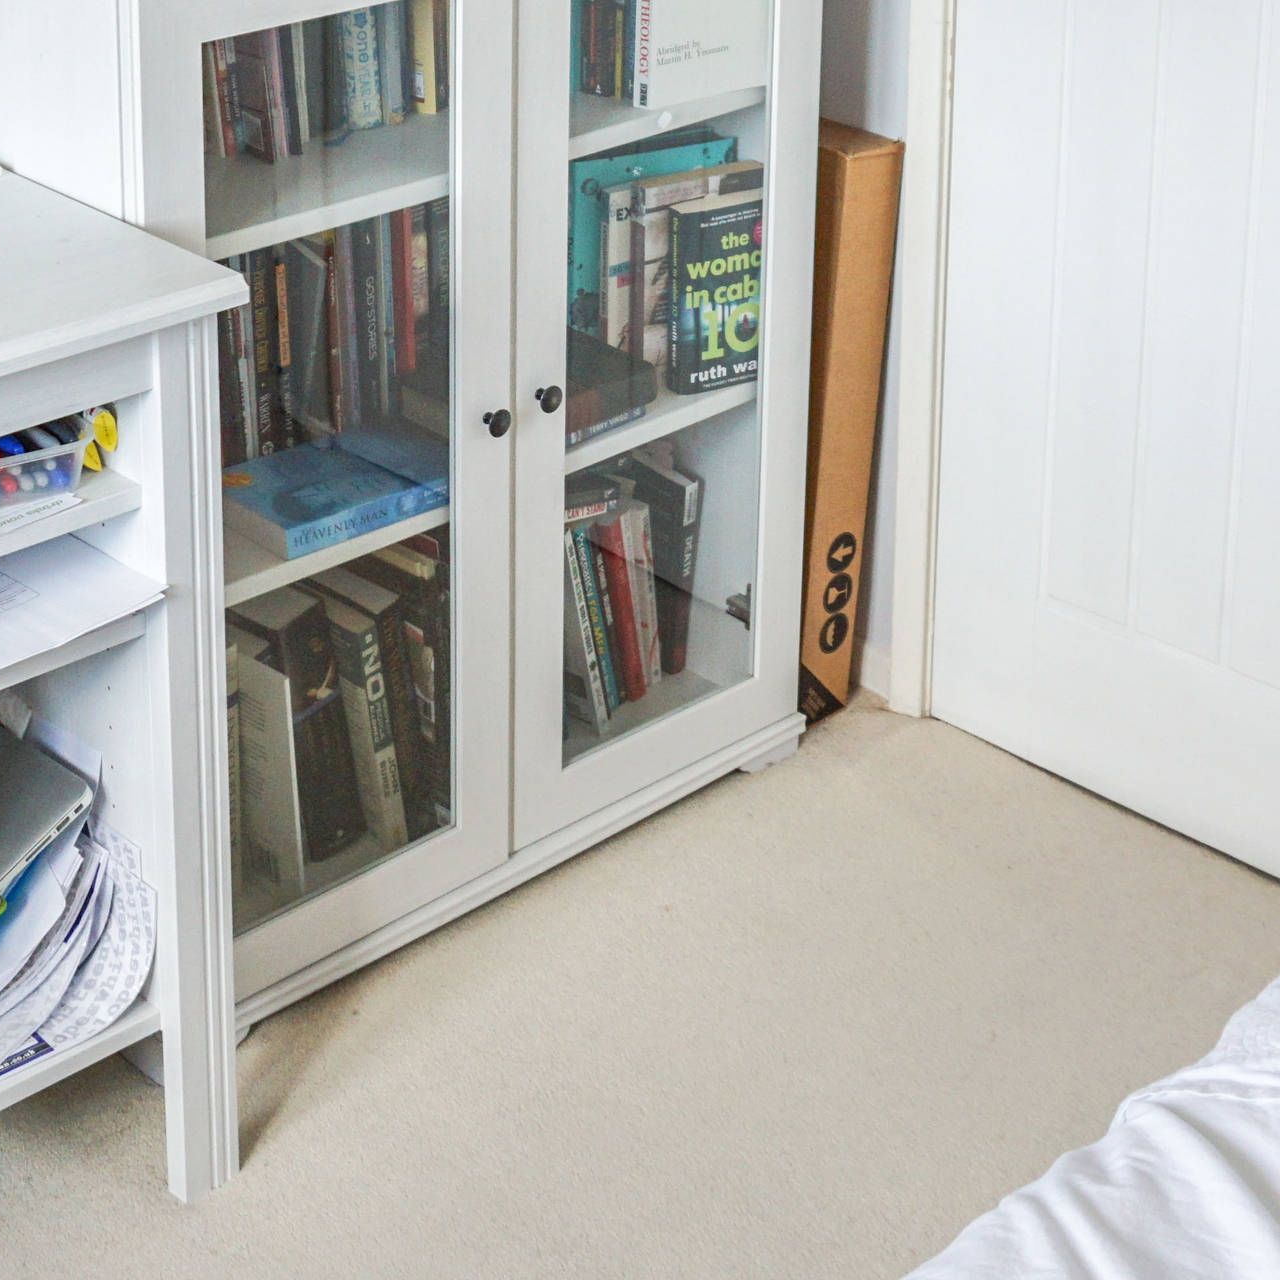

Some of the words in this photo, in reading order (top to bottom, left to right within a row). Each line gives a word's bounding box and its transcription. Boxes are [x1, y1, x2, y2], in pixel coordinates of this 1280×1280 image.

[721, 232, 749, 250] the
[365, 276, 375, 305] GOD
[685, 285, 709, 309] in
[714, 274, 759, 304] cab
[367, 311, 378, 361] STORIES
[701, 302, 759, 361] 10
[690, 364, 727, 383] ruth
[733, 360, 757, 374] wa
[258, 393, 271, 433] WARREN
[293, 518, 355, 547] HEAVENLY
[360, 510, 388, 525] MAN
